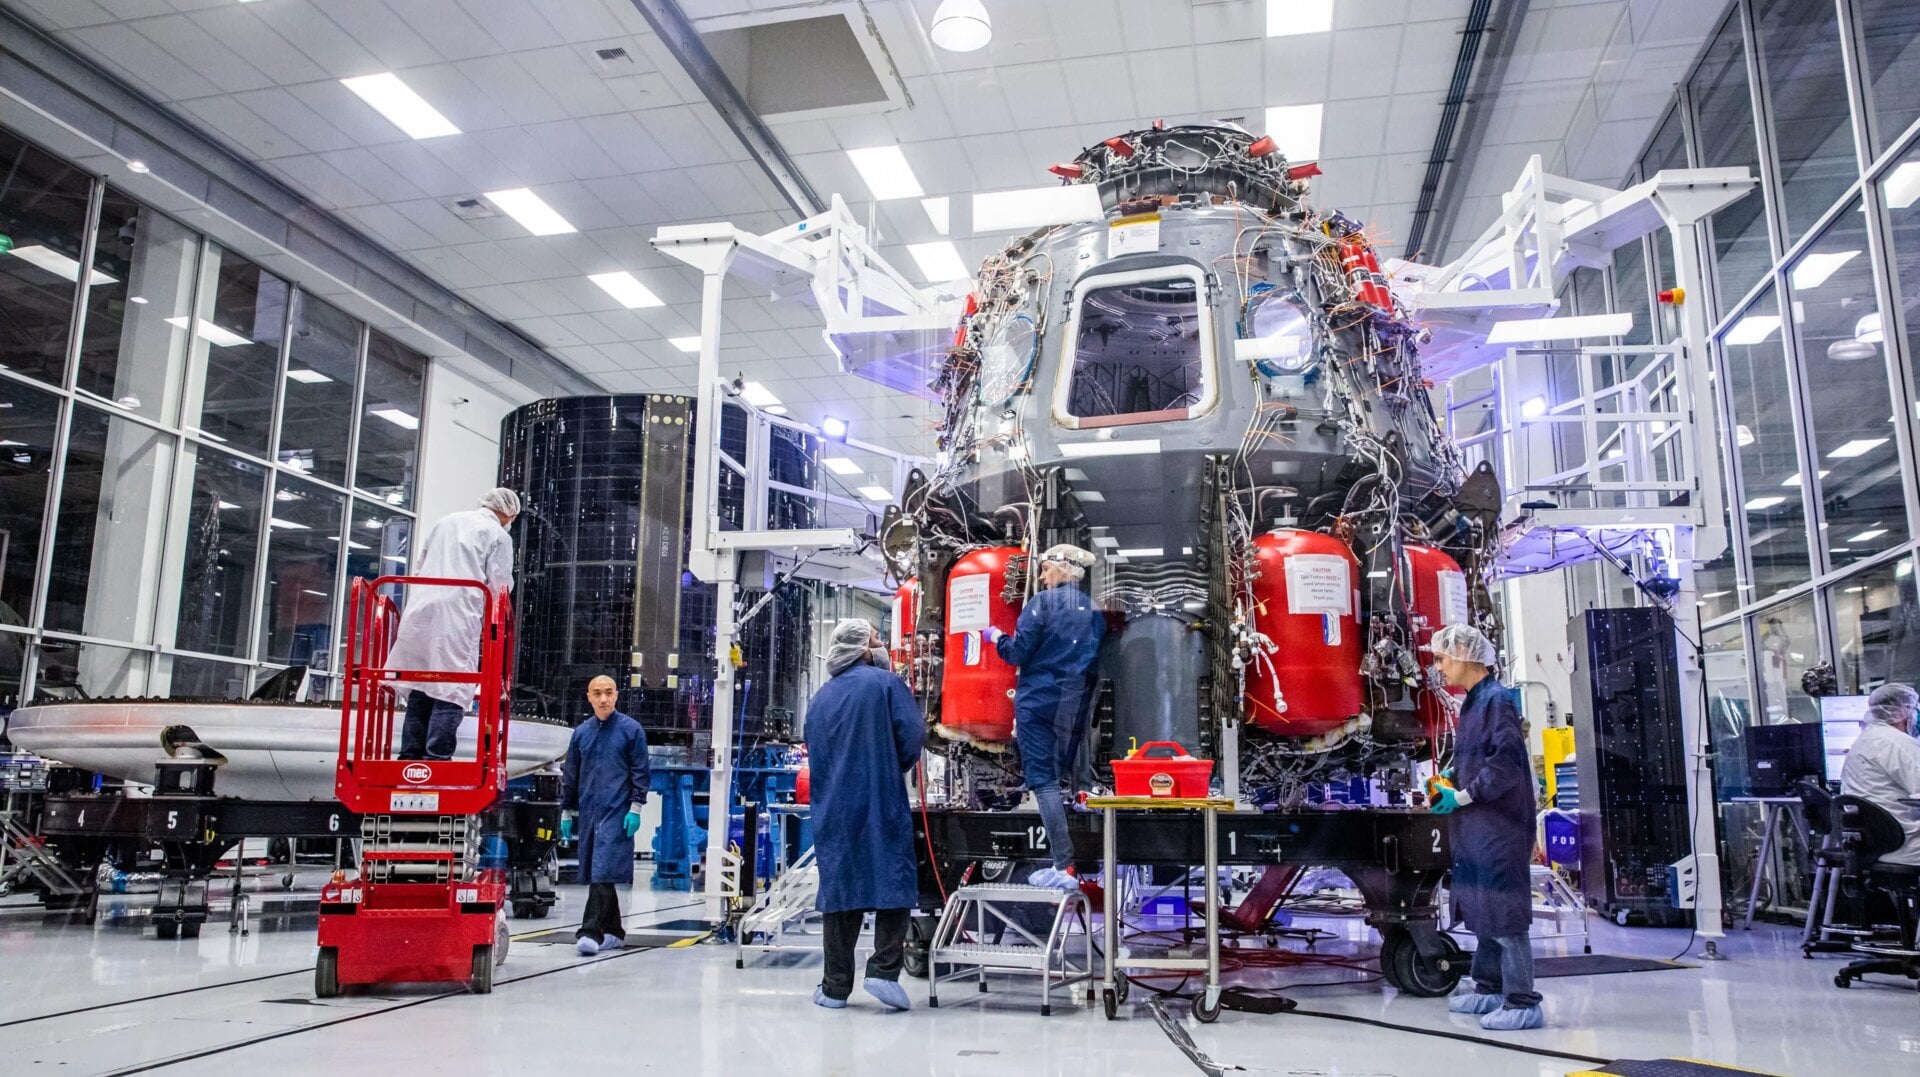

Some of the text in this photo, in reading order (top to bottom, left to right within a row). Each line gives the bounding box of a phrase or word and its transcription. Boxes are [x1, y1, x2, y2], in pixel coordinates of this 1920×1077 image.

[406, 767, 428, 779] mec
[77, 809, 85, 828] 4
[167, 810, 178, 830] 5
[328, 813, 339, 832] 6
[1027, 826, 1046, 849] 12
[1229, 831, 1236, 855] 1
[1431, 828, 1441, 852] 2
